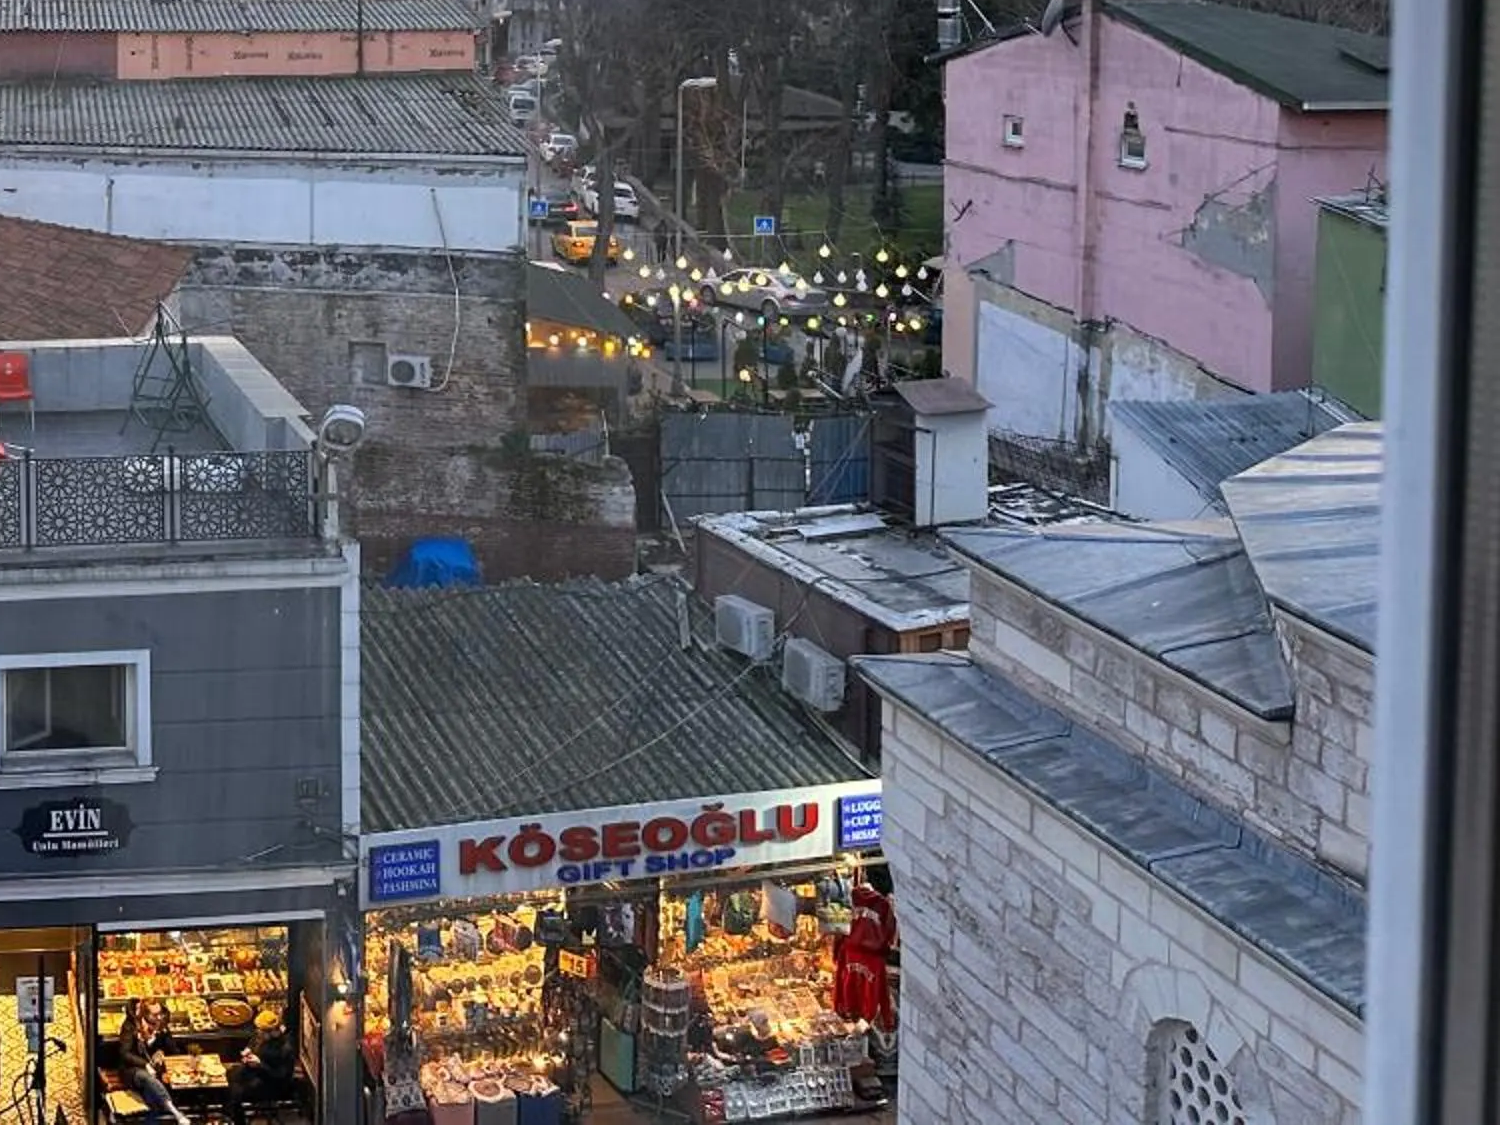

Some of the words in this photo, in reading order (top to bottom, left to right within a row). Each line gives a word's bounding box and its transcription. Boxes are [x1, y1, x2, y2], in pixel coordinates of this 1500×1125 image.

[851, 800, 881, 813] LUGG
[50, 803, 101, 831] EVİN
[459, 802, 819, 876] KÖSEOĞLU
[383, 848, 435, 864] CERAMIC
[383, 862, 436, 880] HOOKAH
[557, 858, 636, 883] GIFT
[645, 848, 736, 874] SHOP
[383, 878, 437, 895] PASHMINA
